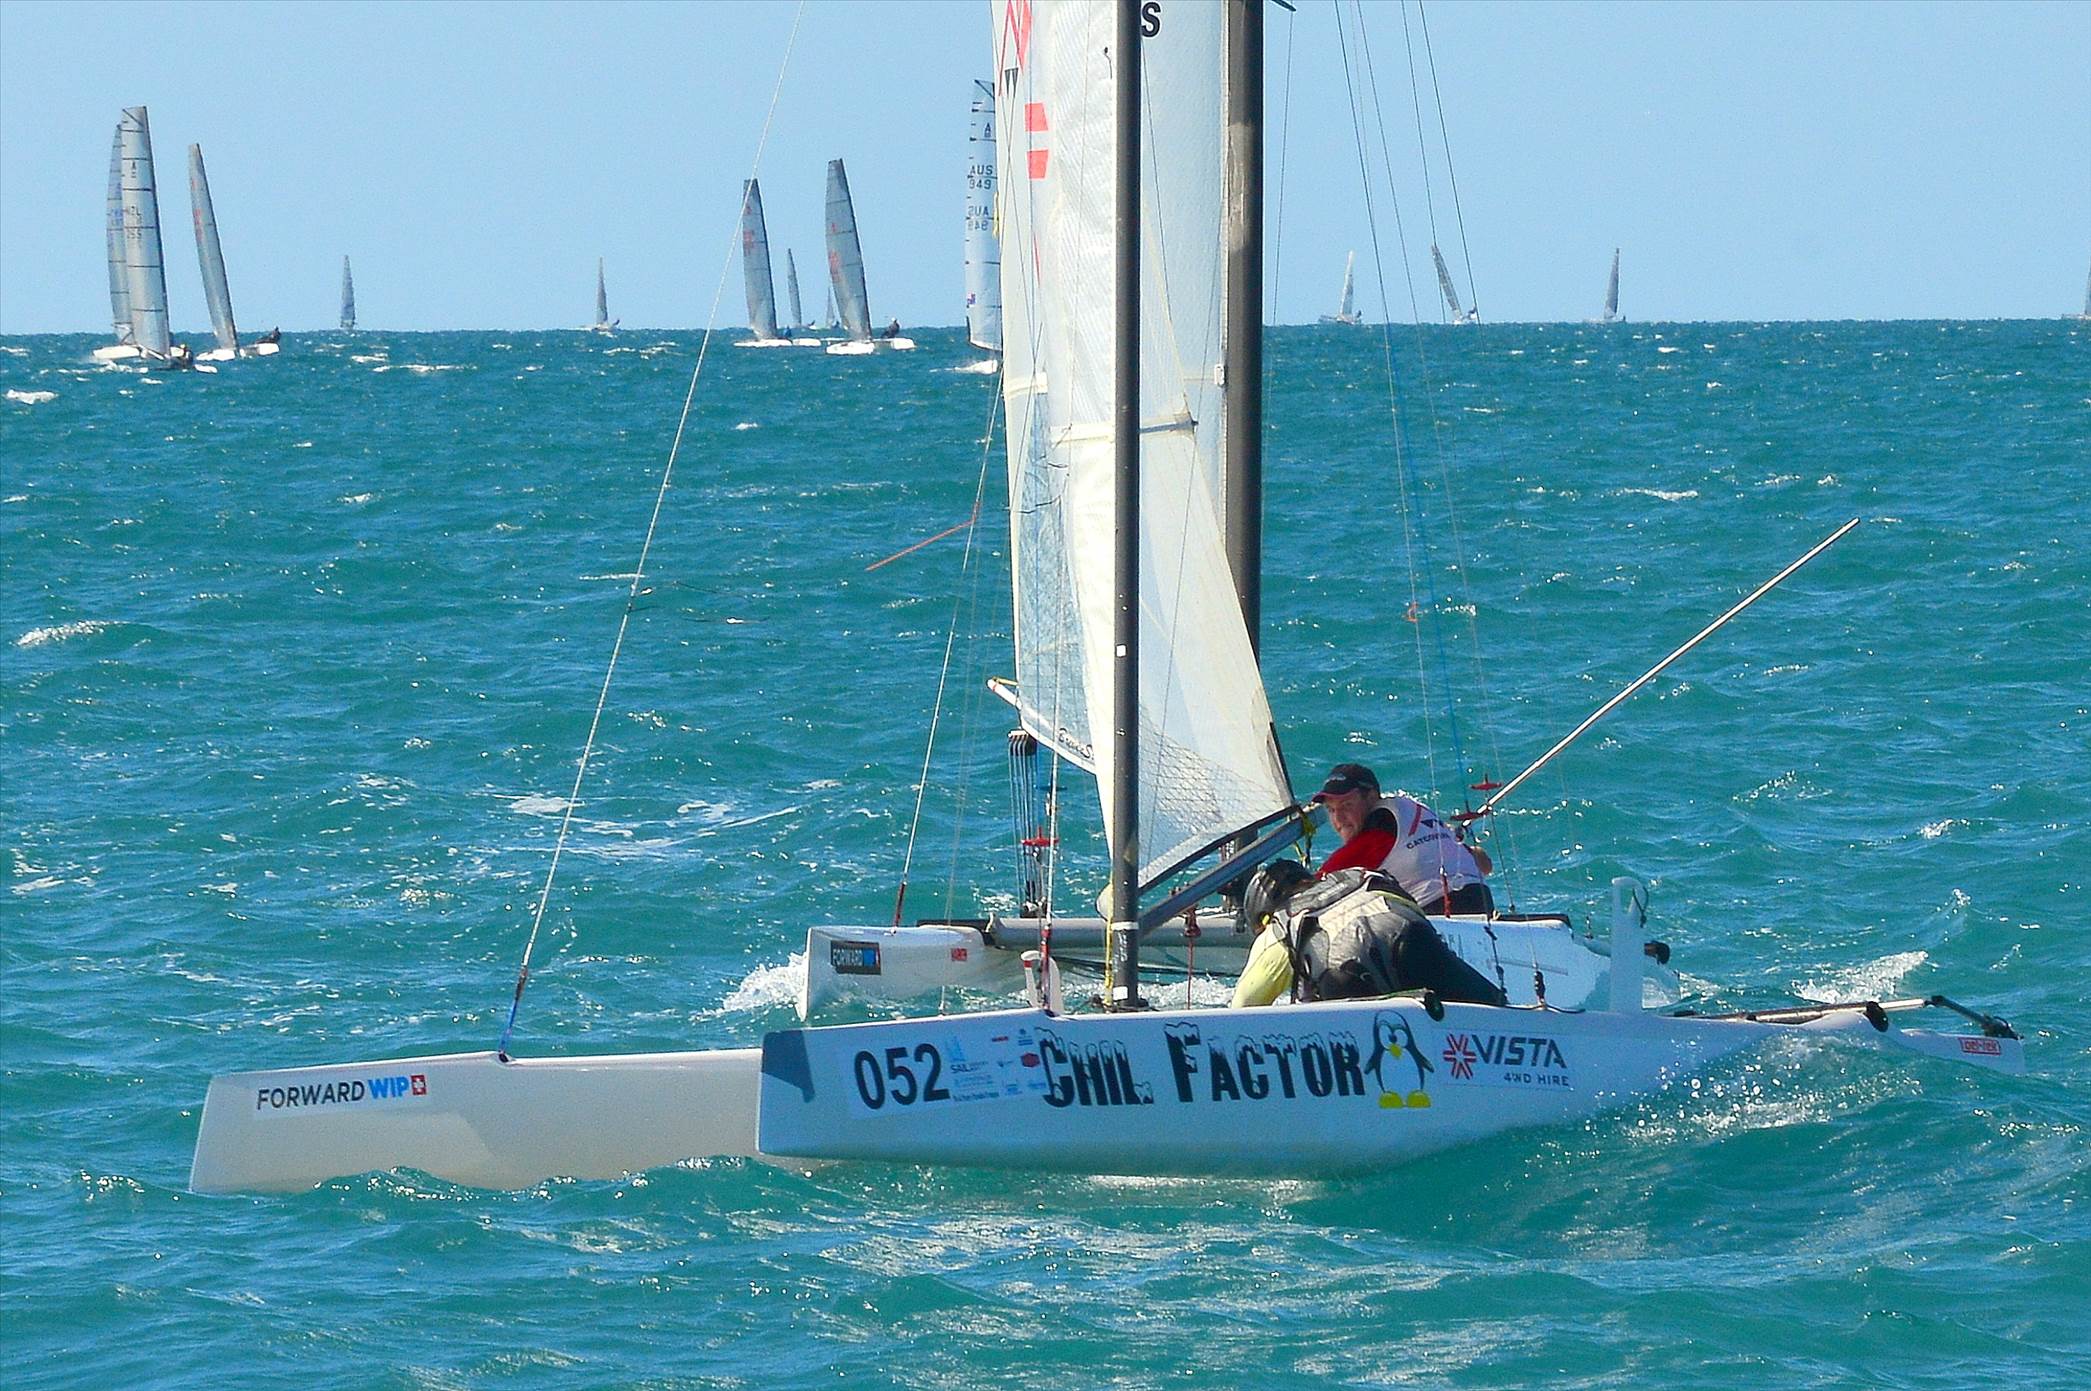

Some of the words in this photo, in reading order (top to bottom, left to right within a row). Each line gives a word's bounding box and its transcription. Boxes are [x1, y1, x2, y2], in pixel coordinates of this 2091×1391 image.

[969, 164, 994, 175] AUS
[1163, 1021, 1366, 1103] FACTOR
[1472, 1034, 1567, 1069] VISTA
[257, 1081, 365, 1111] FORWARD
[368, 1076, 410, 1100] WIP
[854, 1043, 949, 1110] 052
[1504, 1072, 1532, 1084] 4WD
[1538, 1074, 1570, 1087] HIRE
